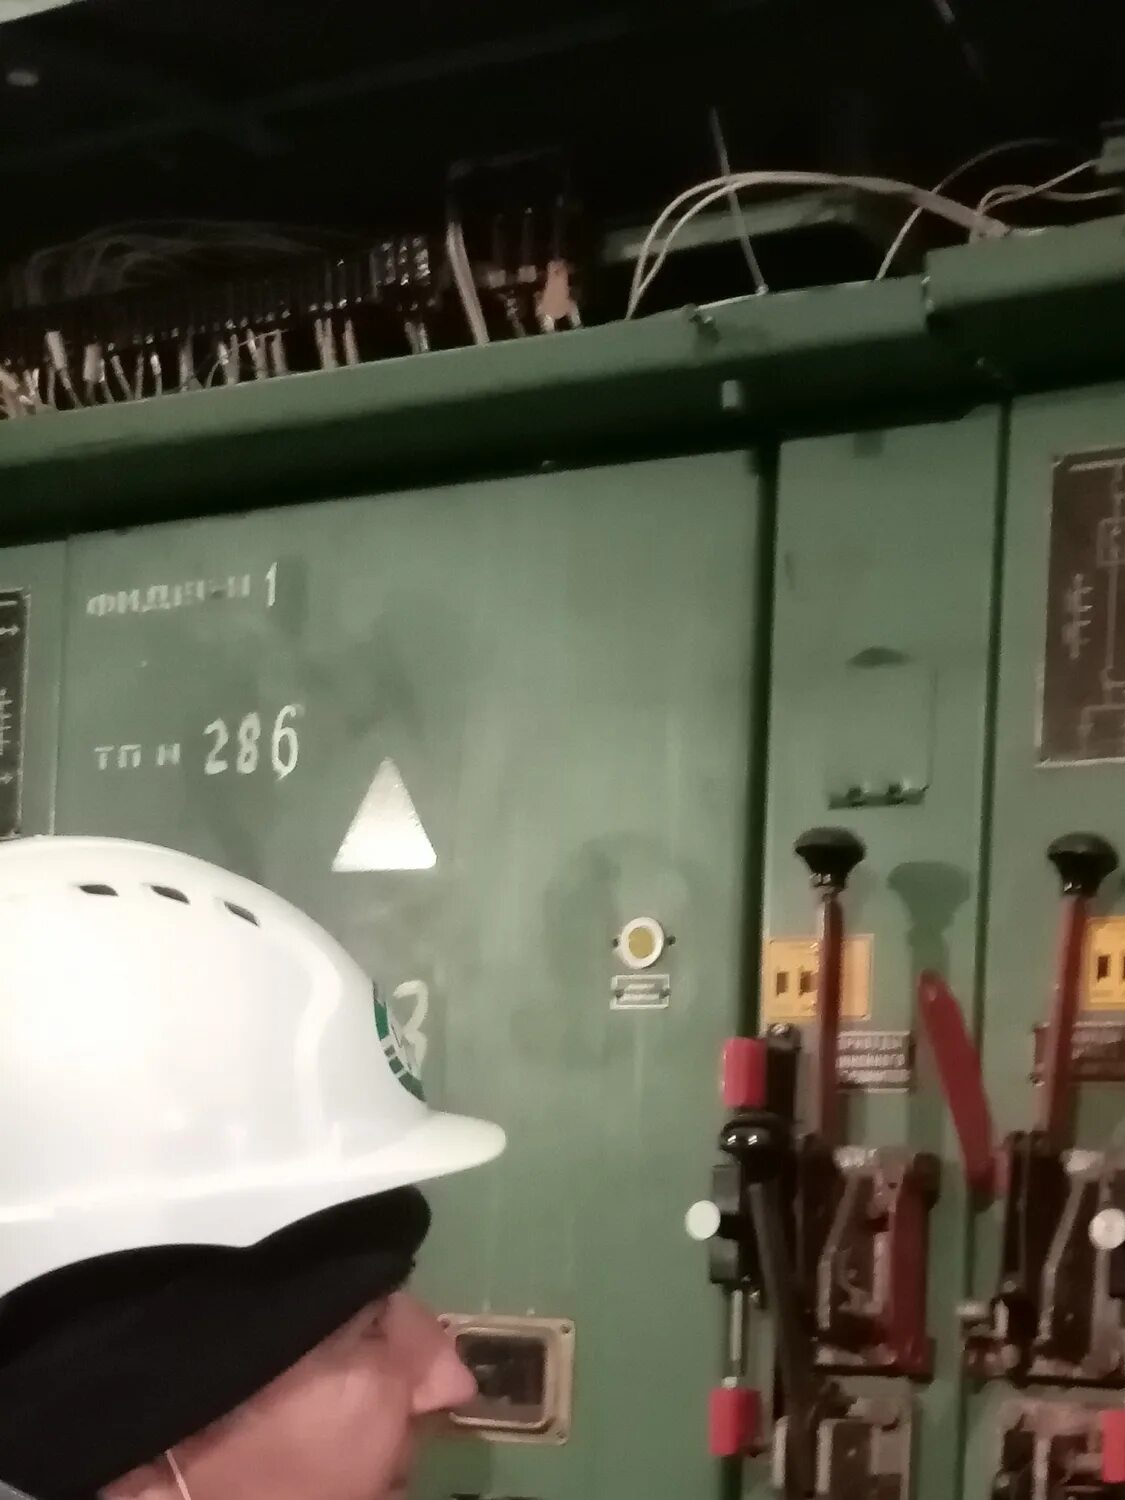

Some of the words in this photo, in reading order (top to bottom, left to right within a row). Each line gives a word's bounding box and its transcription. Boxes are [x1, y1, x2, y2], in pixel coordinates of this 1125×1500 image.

[264, 562, 278, 607] 1
[94, 743, 142, 771] ТП
[203, 704, 300, 781] 286
